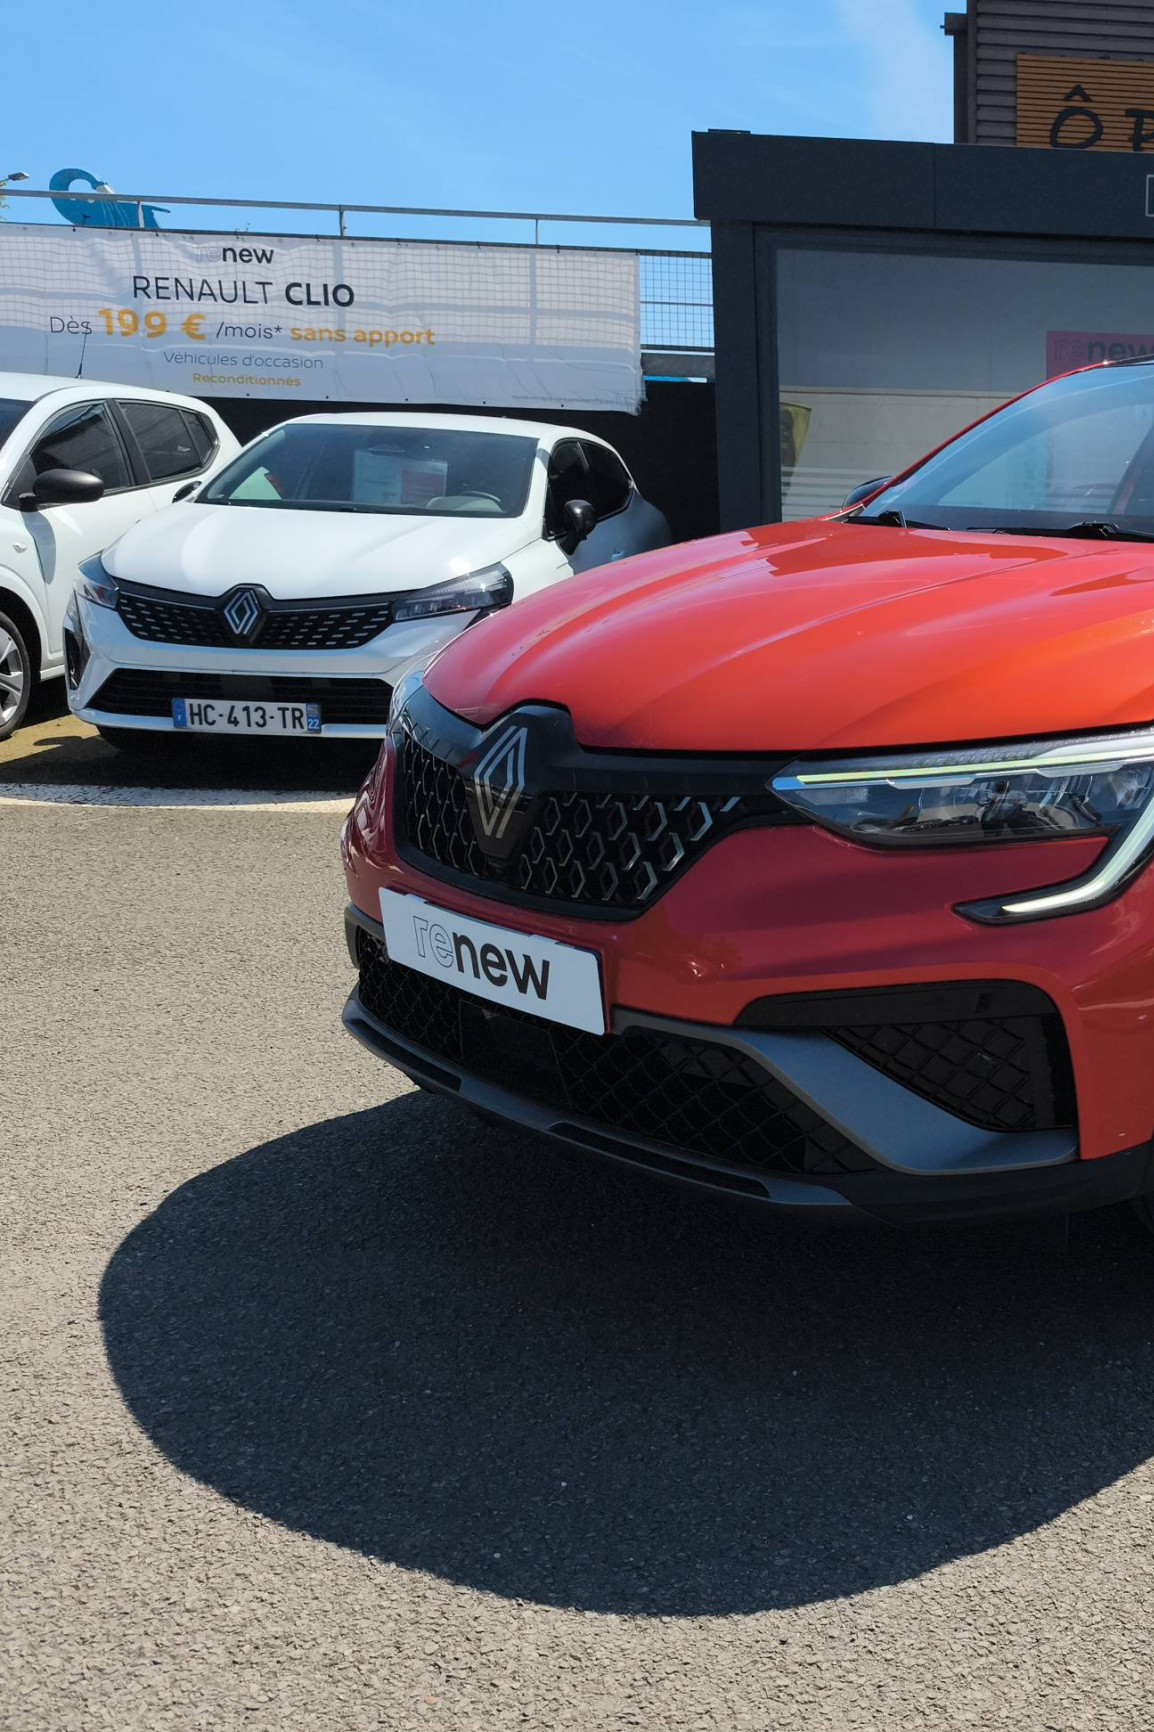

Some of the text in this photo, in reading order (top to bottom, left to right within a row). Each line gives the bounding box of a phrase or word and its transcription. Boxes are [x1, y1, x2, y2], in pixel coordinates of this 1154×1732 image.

[1050, 84, 1104, 150] Ô
[132, 275, 355, 307] RENAULT CLIO
[50, 315, 93, 335] Dès
[98, 308, 167, 339] 199
[290, 327, 347, 342] sans
[352, 328, 436, 347] apport
[163, 351, 325, 369] Véhicules d'occasion
[192, 372, 302, 387] Reconditionnés
[188, 703, 306, 730] HC-413-TR
[308, 718, 320, 730] 22
[412, 915, 550, 1001] renew
